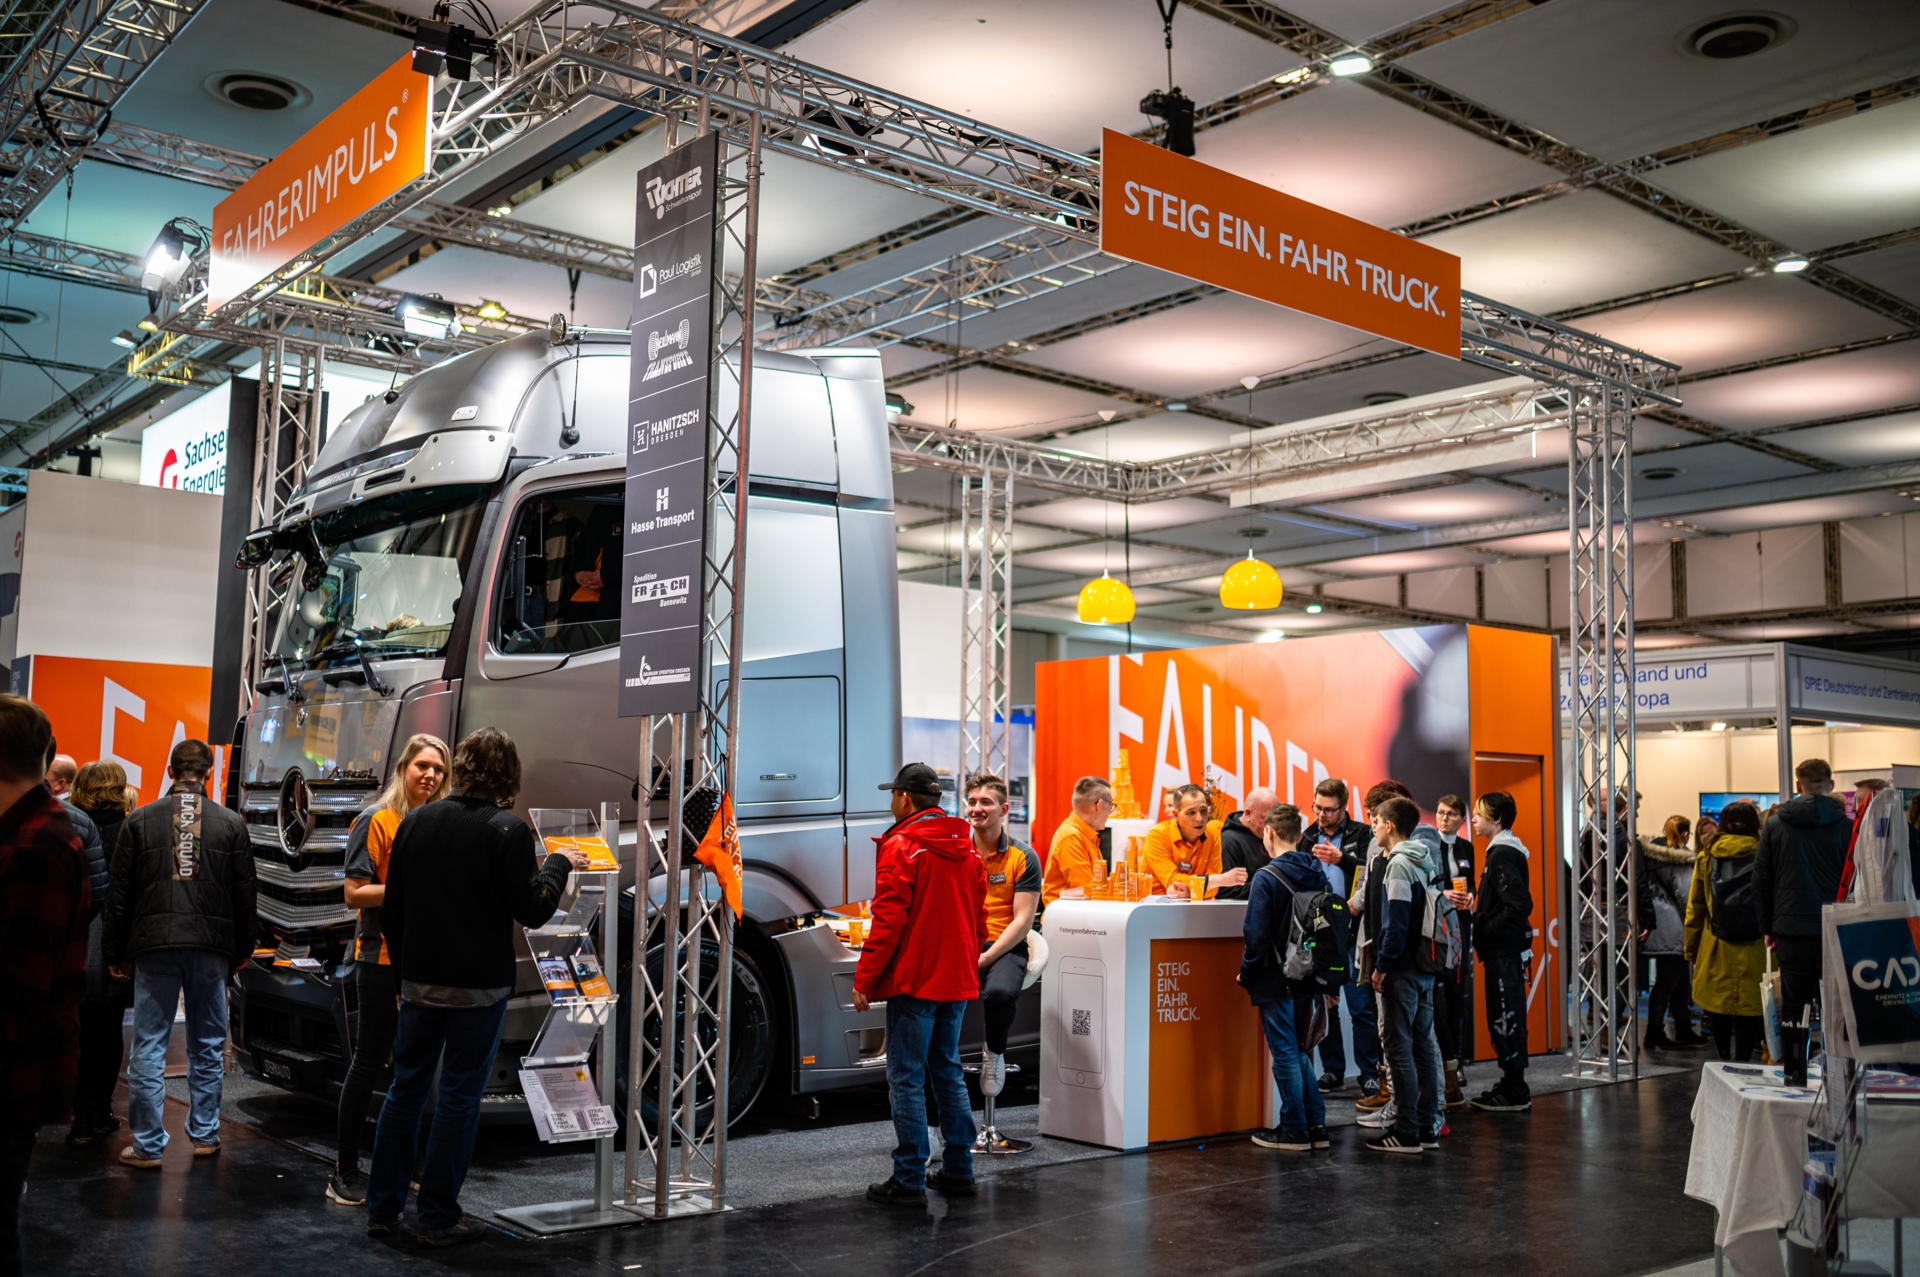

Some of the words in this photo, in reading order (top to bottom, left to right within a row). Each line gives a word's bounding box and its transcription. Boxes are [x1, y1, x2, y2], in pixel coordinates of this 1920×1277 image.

[646, 165, 702, 209] RICHTER
[665, 188, 702, 212] Schwertransport
[1124, 180, 1210, 239] STEIG
[1218, 211, 1272, 261] EIN.
[1279, 232, 1350, 287] FAHR
[1355, 258, 1447, 318] TRUCK.
[659, 264, 675, 282] Paul
[676, 253, 702, 275] Logistik
[641, 349, 694, 383] TRANSPORTE
[651, 408, 700, 437] HANITZSCH
[650, 428, 684, 446] DRESDEN
[631, 520, 655, 535] Hasse
[655, 508, 695, 529] Transport
[633, 573, 658, 585] Spedition
[659, 596, 688, 608] Bannewitz
[1674, 662, 1708, 681] und
[1804, 675, 1823, 692] SPIE
[1823, 678, 1868, 697] Deutschland
[1868, 686, 1882, 699] und
[180, 793, 195, 828] BLACK
[178, 831, 195, 878] SQUAD
[1059, 926, 1108, 937] #steigeinfahrtruck
[1156, 961, 1191, 977] STEIG
[1156, 977, 1180, 993] EIN.
[1156, 992, 1189, 1008] FAHR
[1874, 992, 1906, 1001] CHEMNITZ
[1156, 1006, 1201, 1024] TRUCK.
